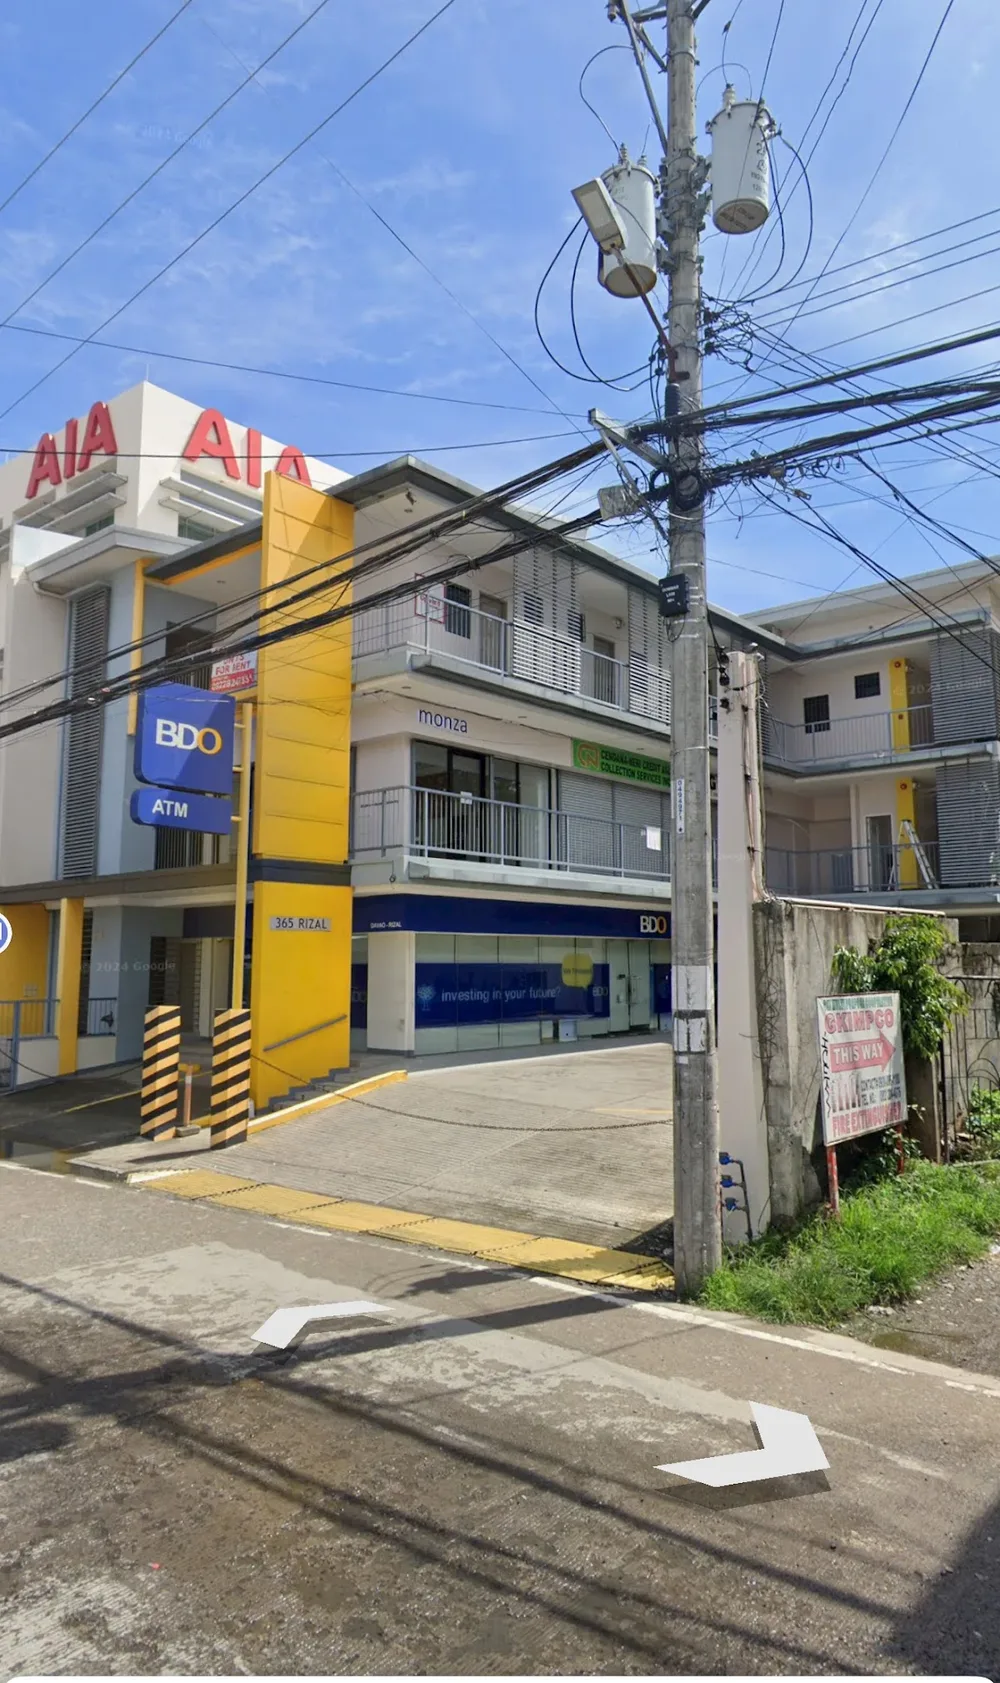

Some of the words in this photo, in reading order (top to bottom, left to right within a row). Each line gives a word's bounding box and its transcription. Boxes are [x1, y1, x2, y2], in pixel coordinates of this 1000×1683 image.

[26, 401, 118, 498] AIA
[181, 407, 313, 488] AIA
[418, 708, 468, 733] monza
[155, 718, 222, 755] BDO
[601, 761, 636, 779] COLLECTION
[637, 771, 661, 786] SERVICES
[151, 798, 189, 818] ATM
[275, 917, 294, 928] 365
[298, 917, 328, 929] RIZAL
[640, 915, 666, 933] BDO
[441, 988, 489, 1003] investing
[492, 989, 502, 1000] in
[504, 989, 526, 1002] your
[529, 986, 561, 999] future?
[833, 1045, 860, 1066] THIS
[861, 1042, 884, 1061] WAY
